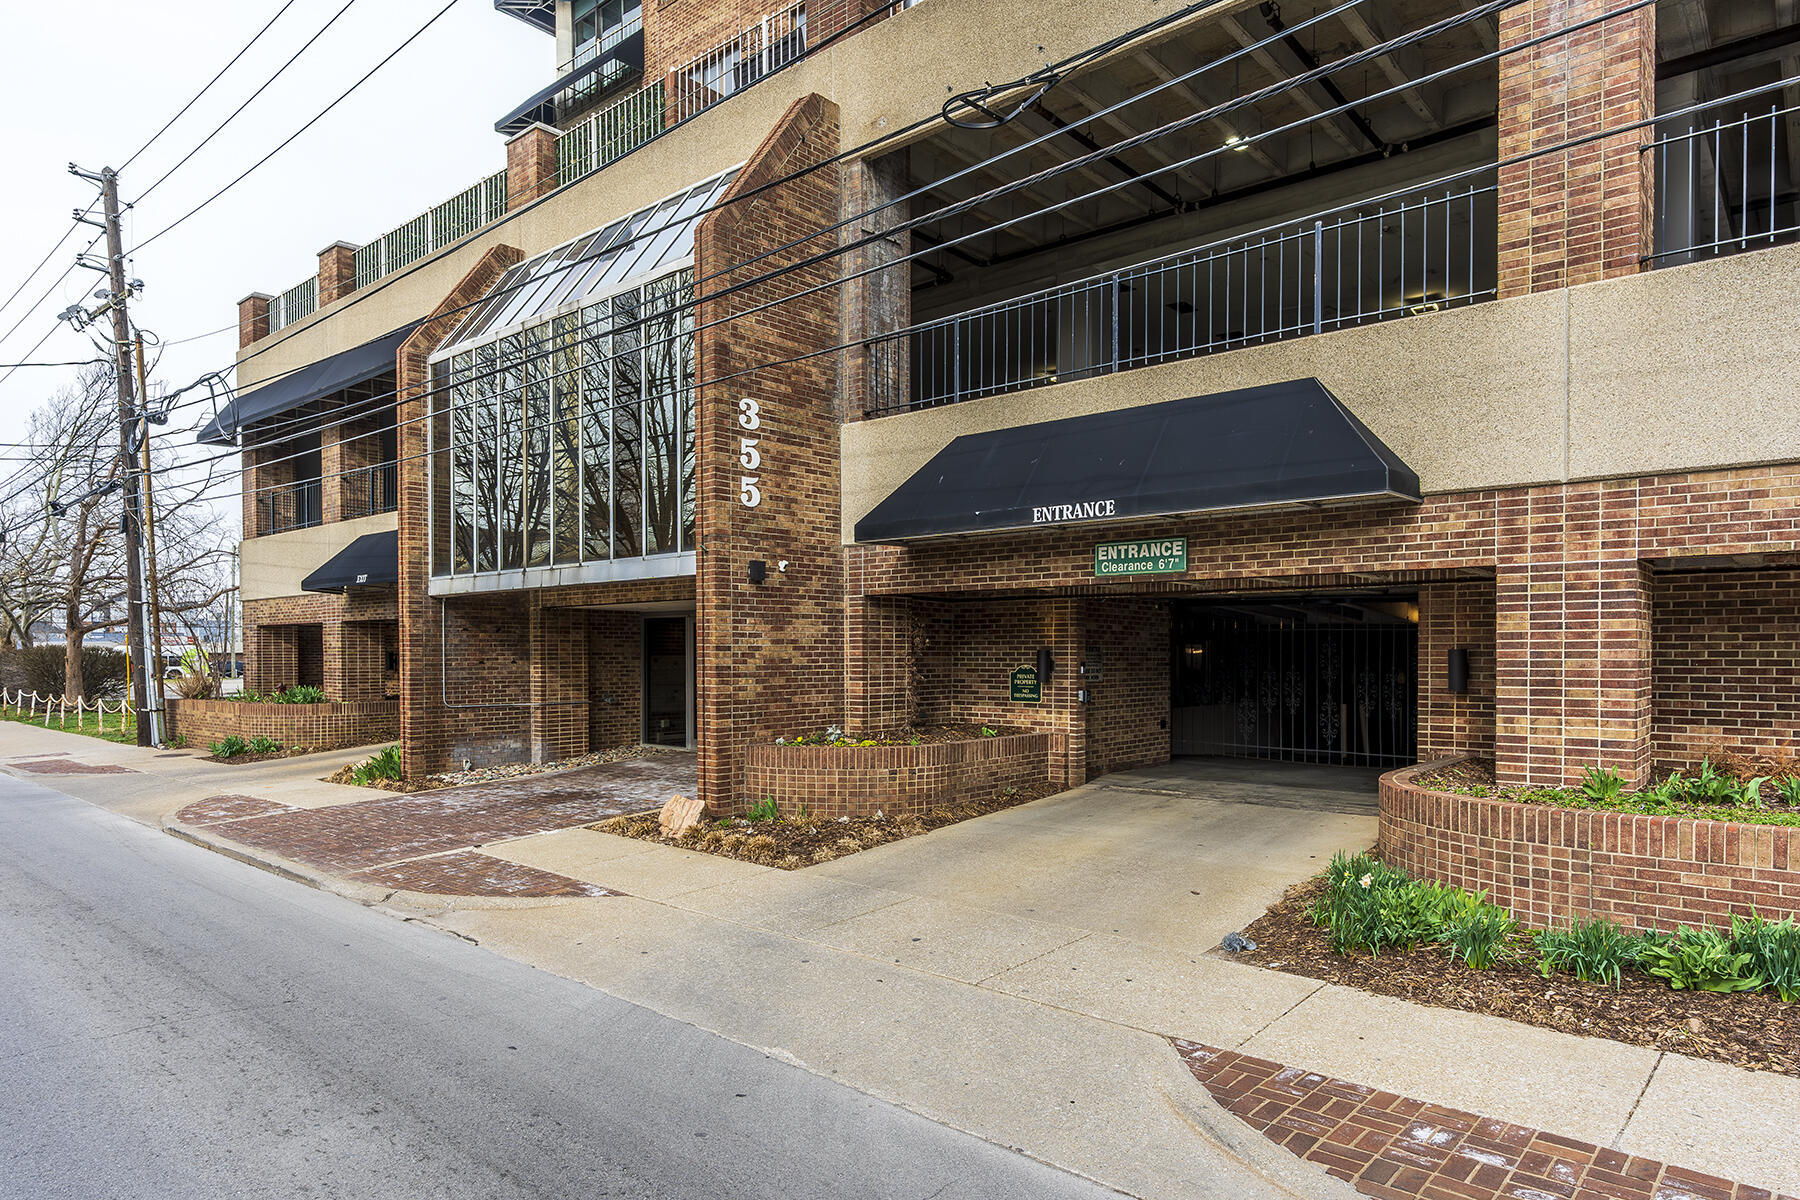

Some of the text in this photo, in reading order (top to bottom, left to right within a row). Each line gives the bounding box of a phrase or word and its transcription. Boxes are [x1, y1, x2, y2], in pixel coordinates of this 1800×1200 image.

[738, 398, 761, 507] 355
[1032, 499, 1116, 523] ENTRANCE
[1098, 541, 1183, 560] ENTRANCE
[1101, 559, 1153, 573] Clearance
